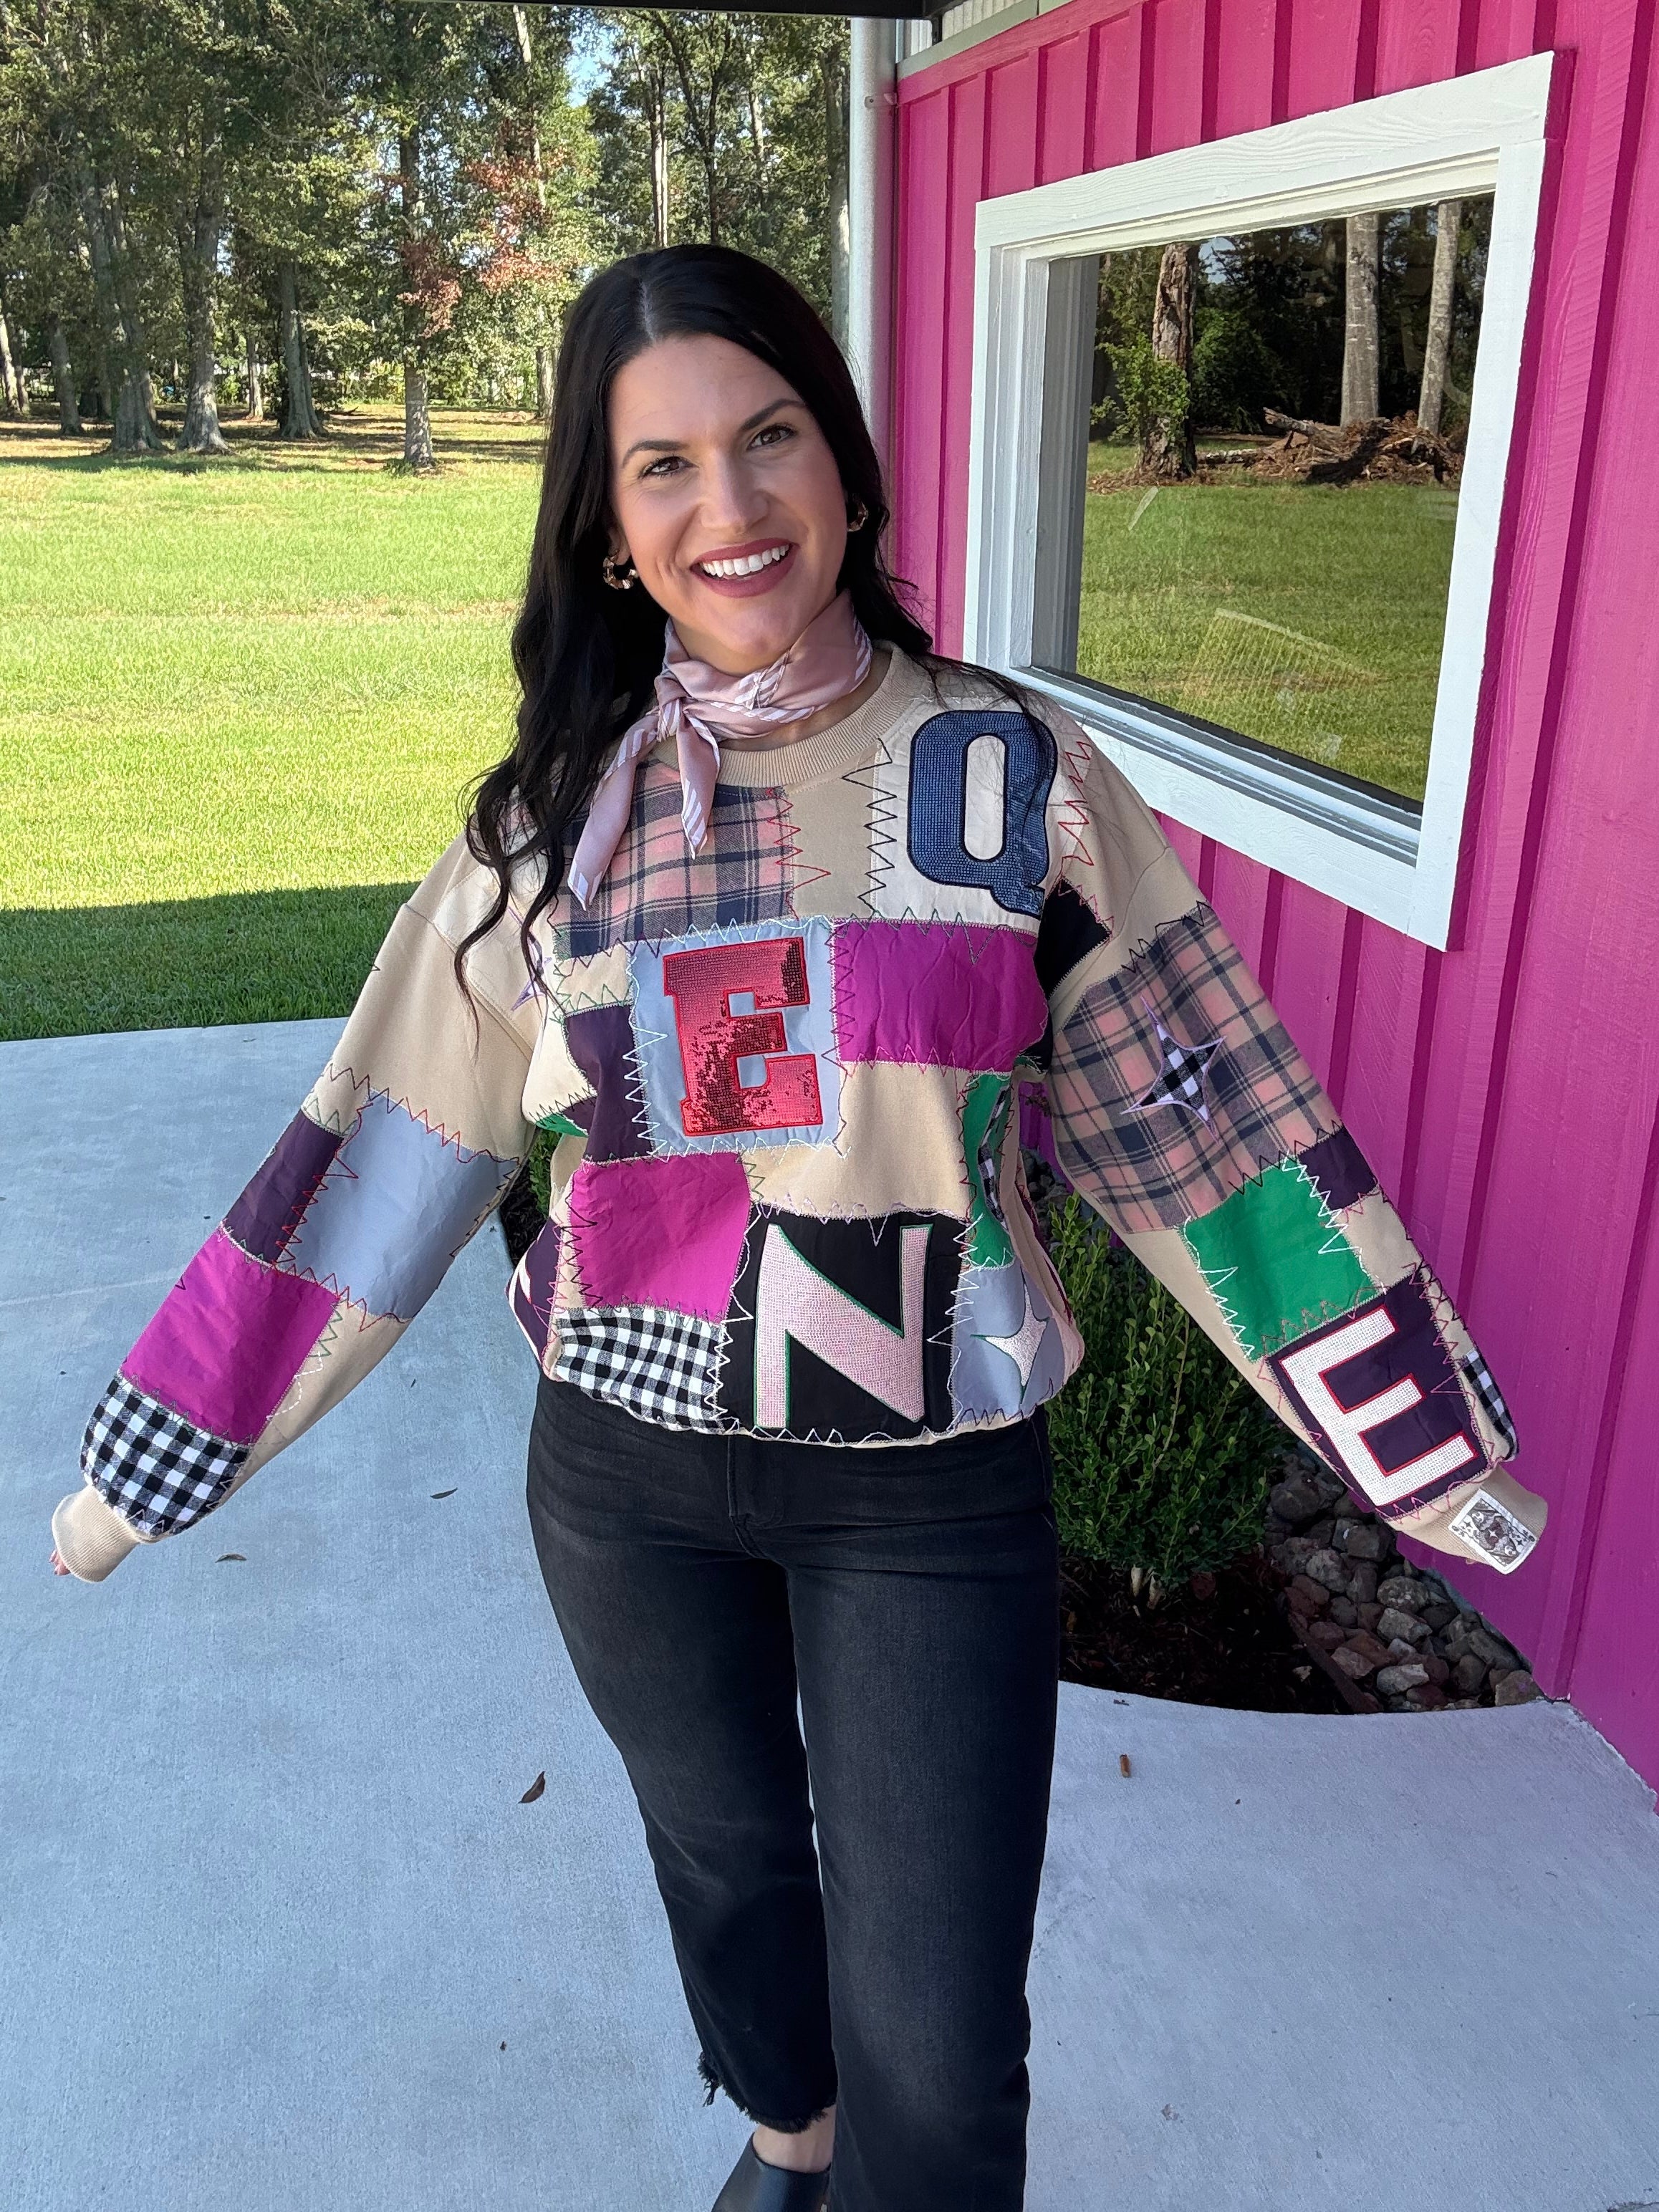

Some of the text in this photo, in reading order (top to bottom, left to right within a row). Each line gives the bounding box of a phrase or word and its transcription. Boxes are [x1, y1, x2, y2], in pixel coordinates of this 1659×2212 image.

[907, 710, 1058, 920] Q
[663, 936, 824, 1137] E
[754, 1223, 934, 1429] N
[1279, 1304, 1480, 1506] E
